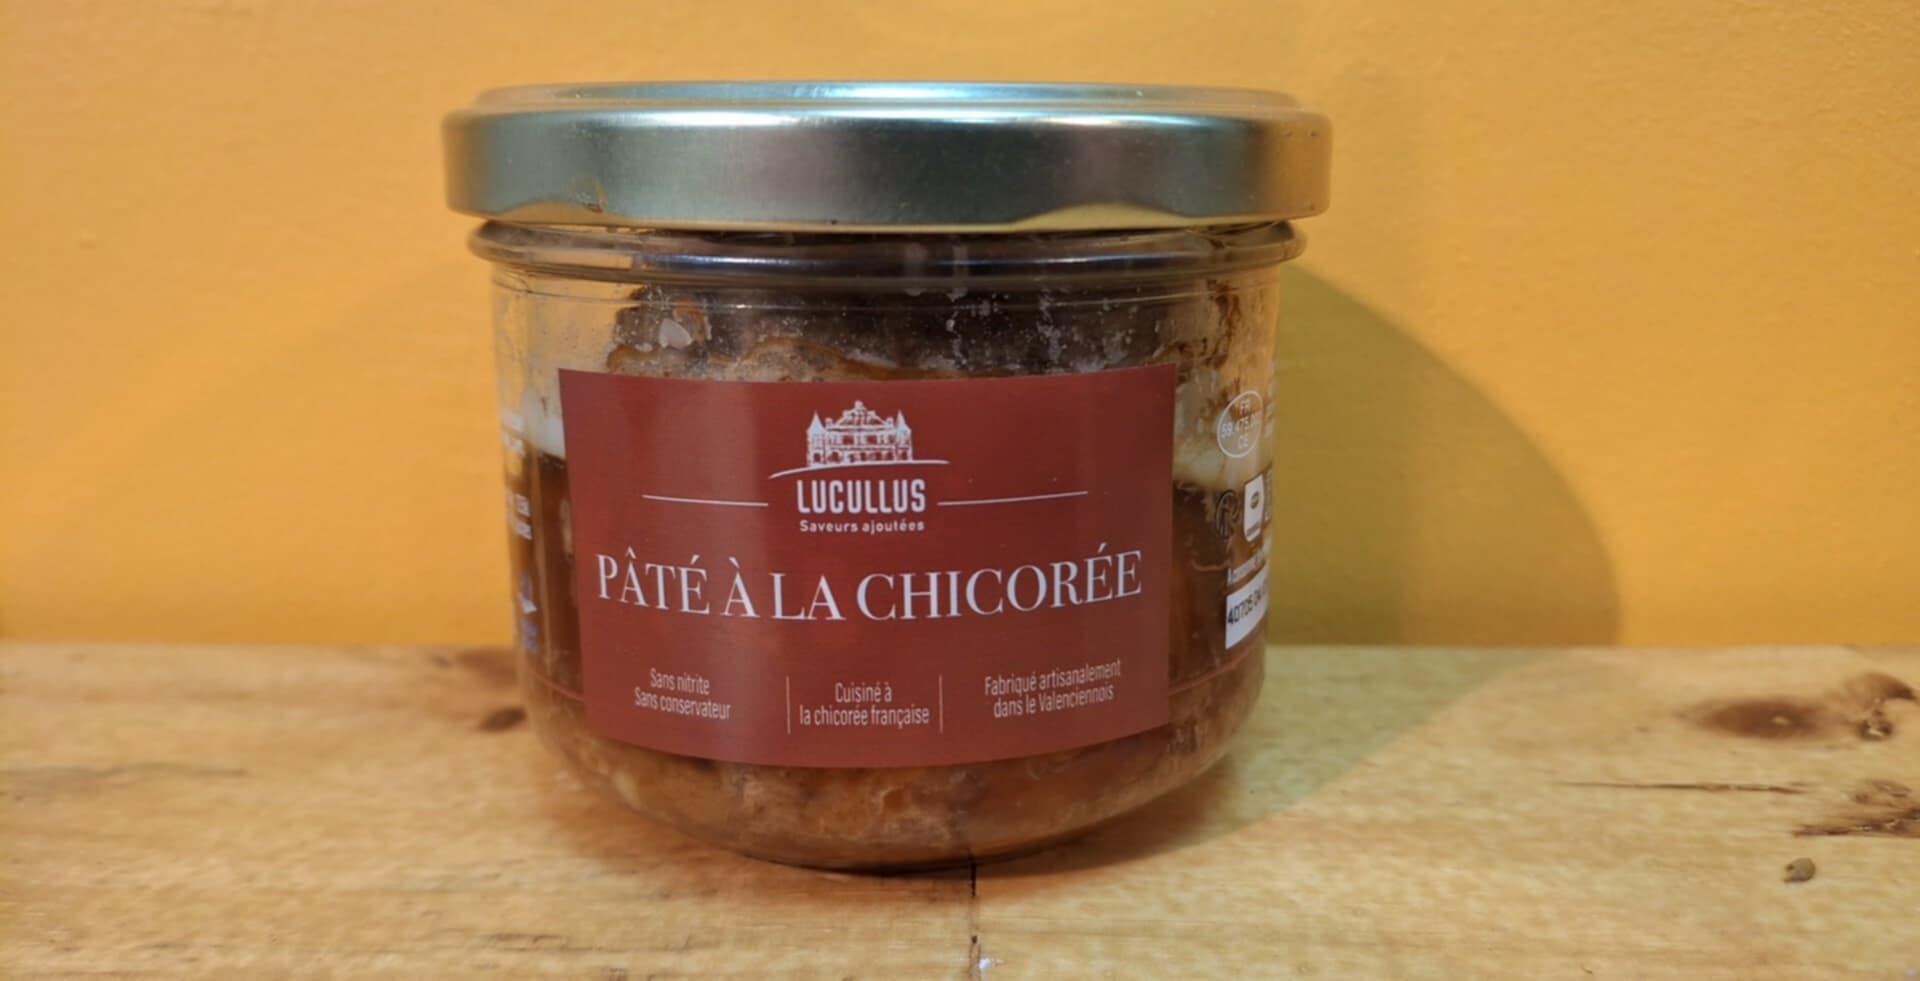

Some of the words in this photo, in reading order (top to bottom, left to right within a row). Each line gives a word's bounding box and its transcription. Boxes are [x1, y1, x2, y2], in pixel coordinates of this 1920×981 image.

[797, 479, 926, 514] LUCULLUS
[800, 519, 858, 533] Saveurs
[862, 518, 925, 535] ajoutées
[596, 546, 710, 615] PÂTÉ
[720, 557, 760, 618] À
[772, 573, 846, 620] LA
[857, 542, 1142, 620] CHICORÉE
[650, 668, 675, 690] Sans
[677, 673, 710, 695] nitrite
[835, 682, 881, 703] Cuisiné
[884, 682, 892, 703] à
[985, 671, 1037, 697] Fabriqué
[1039, 658, 1121, 690] artisanalement
[634, 687, 658, 710] Sans
[660, 695, 731, 720] conservateur
[994, 697, 1023, 718] dans
[1026, 694, 1036, 714] le
[1039, 681, 1114, 712] Valenciennois
[800, 705, 811, 725] la
[814, 705, 868, 726] chicorée
[871, 704, 930, 729] française
